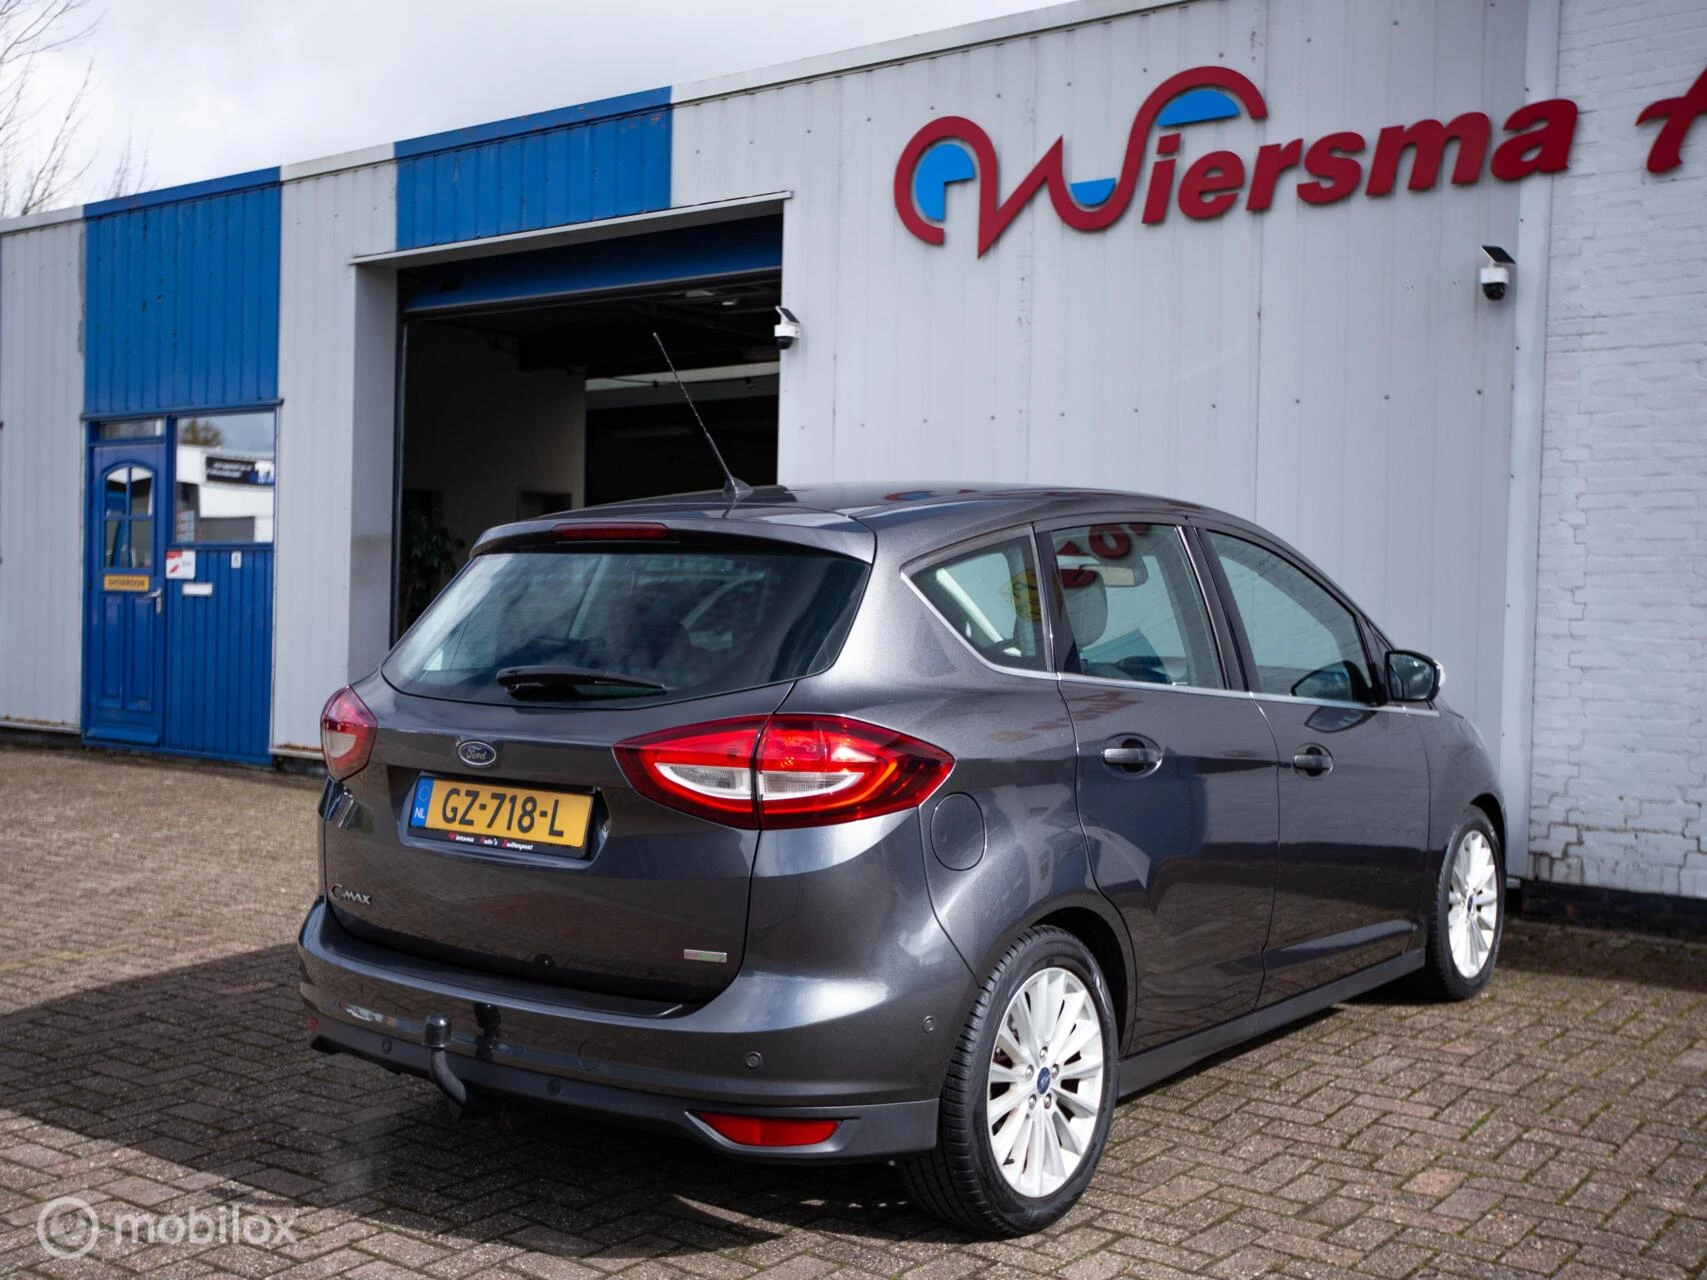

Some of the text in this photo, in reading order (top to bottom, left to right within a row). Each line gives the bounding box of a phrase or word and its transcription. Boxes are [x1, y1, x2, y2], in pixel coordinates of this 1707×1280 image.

[894, 66, 1579, 259] Wiersma
[465, 745, 487, 761] Ford
[414, 806, 426, 820] NL
[442, 787, 565, 838] GZ-718-L
